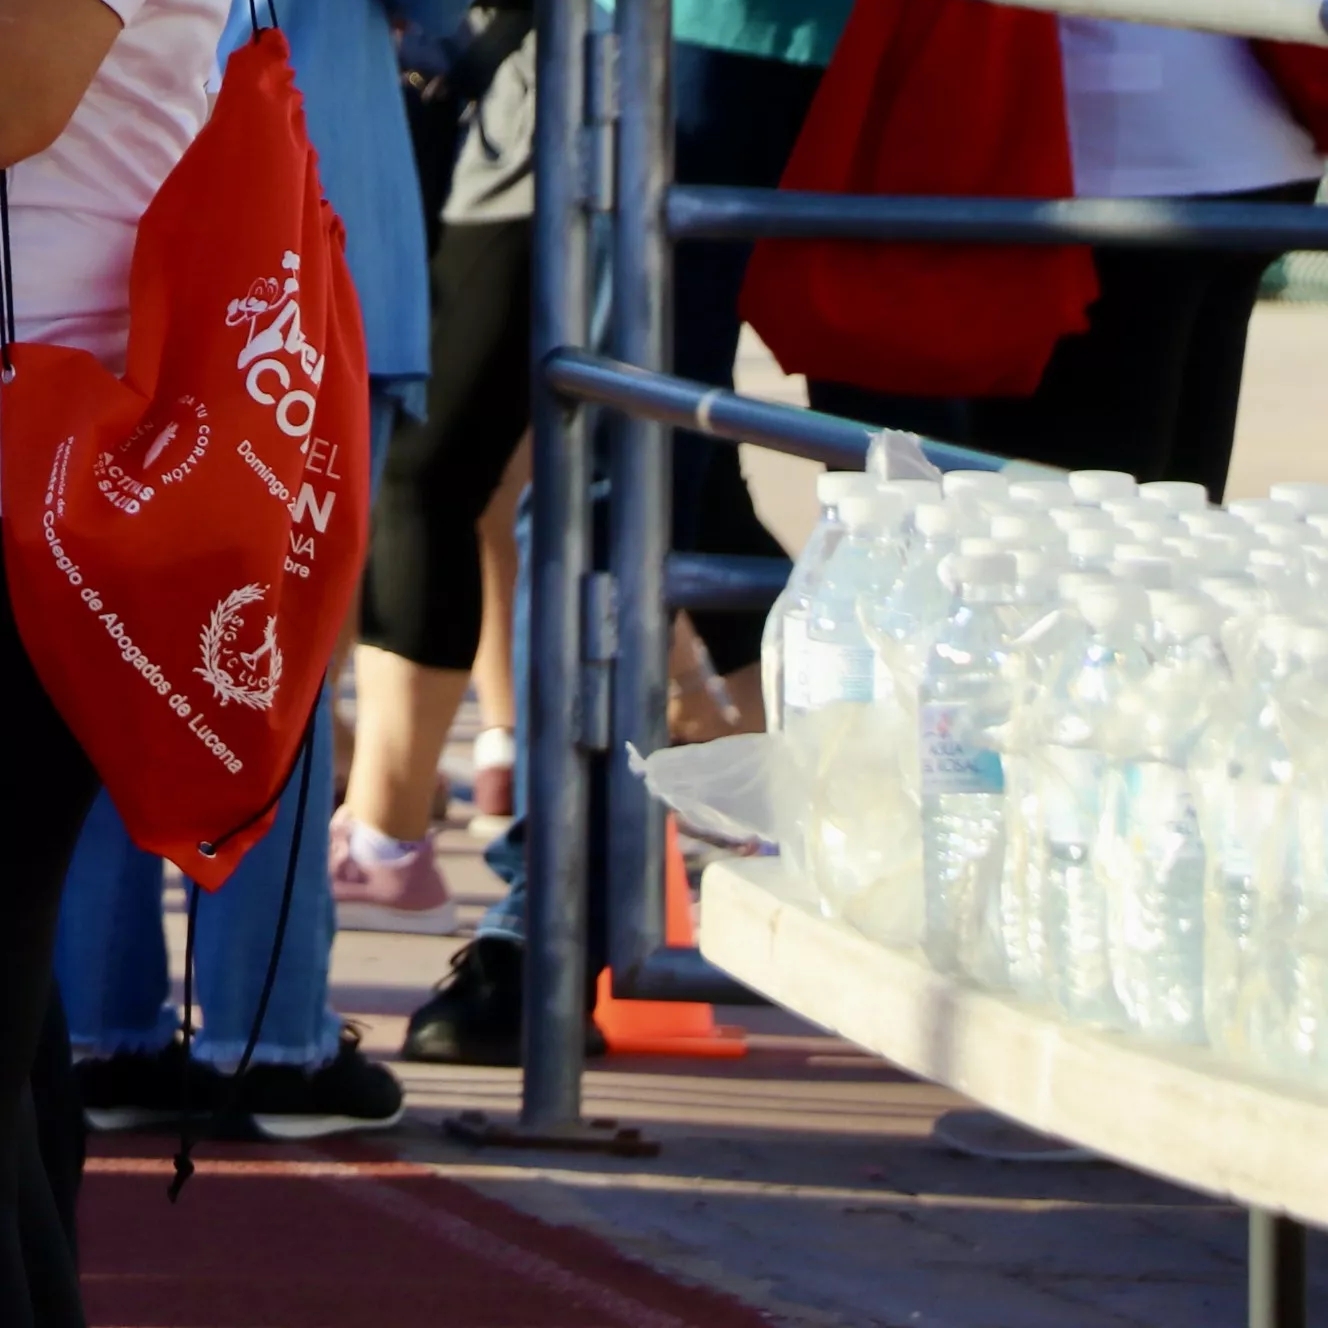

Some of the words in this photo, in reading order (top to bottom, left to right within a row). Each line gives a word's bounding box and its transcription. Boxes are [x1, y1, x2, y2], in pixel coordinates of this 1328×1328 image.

[160, 424, 211, 485] CORAZÓN
[237, 439, 290, 501] Domingo
[43, 510, 83, 586] Colegio
[80, 587, 103, 611] de
[99, 613, 172, 696] Abogados
[168, 693, 192, 718] de
[188, 714, 244, 774] Lucena
